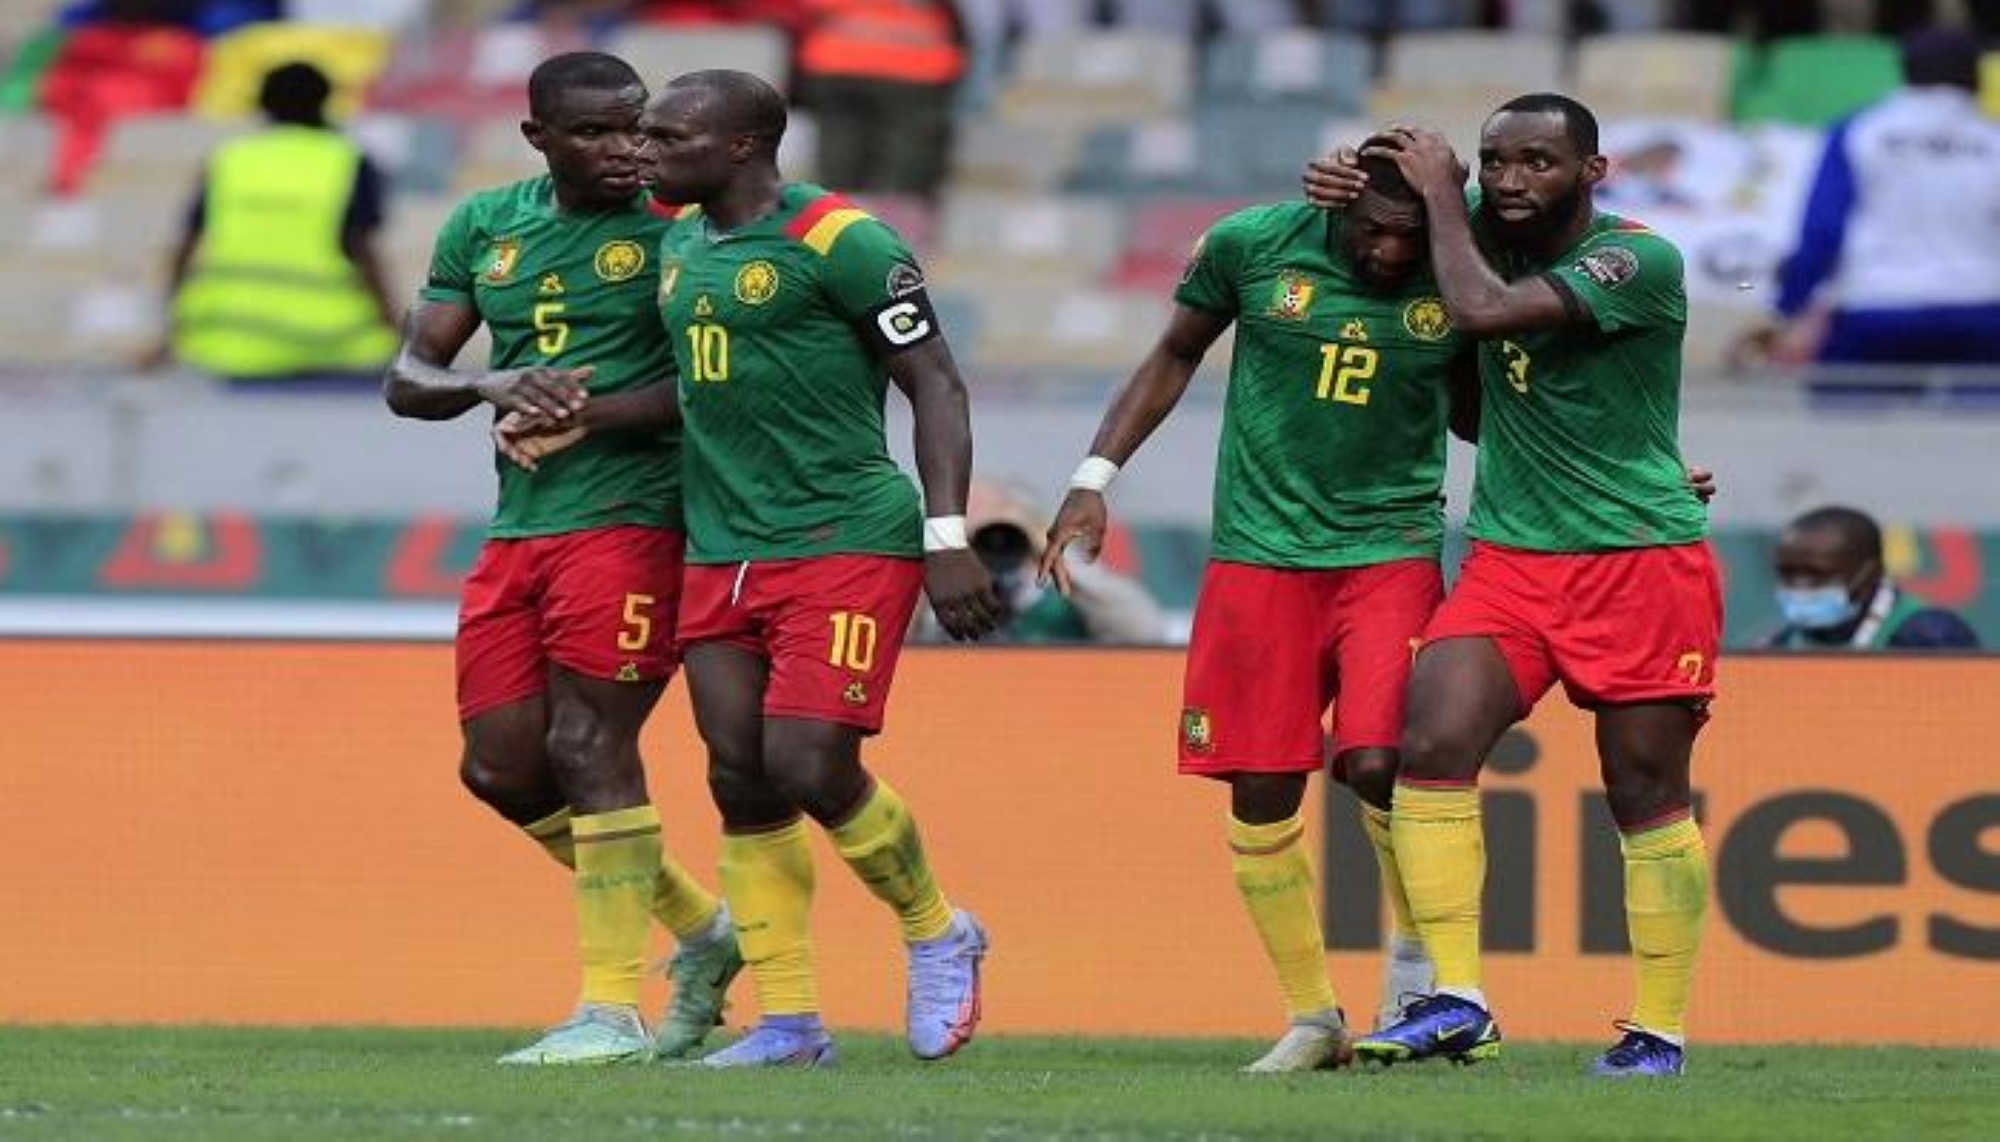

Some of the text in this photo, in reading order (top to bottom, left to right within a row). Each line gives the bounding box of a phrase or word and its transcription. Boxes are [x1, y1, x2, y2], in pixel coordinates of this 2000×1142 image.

[534, 303, 568, 355] 5
[687, 324, 728, 382] 10
[1316, 344, 1377, 405] 12
[1503, 340, 1530, 393] 3
[616, 593, 656, 651] 5
[828, 611, 876, 671] 10
